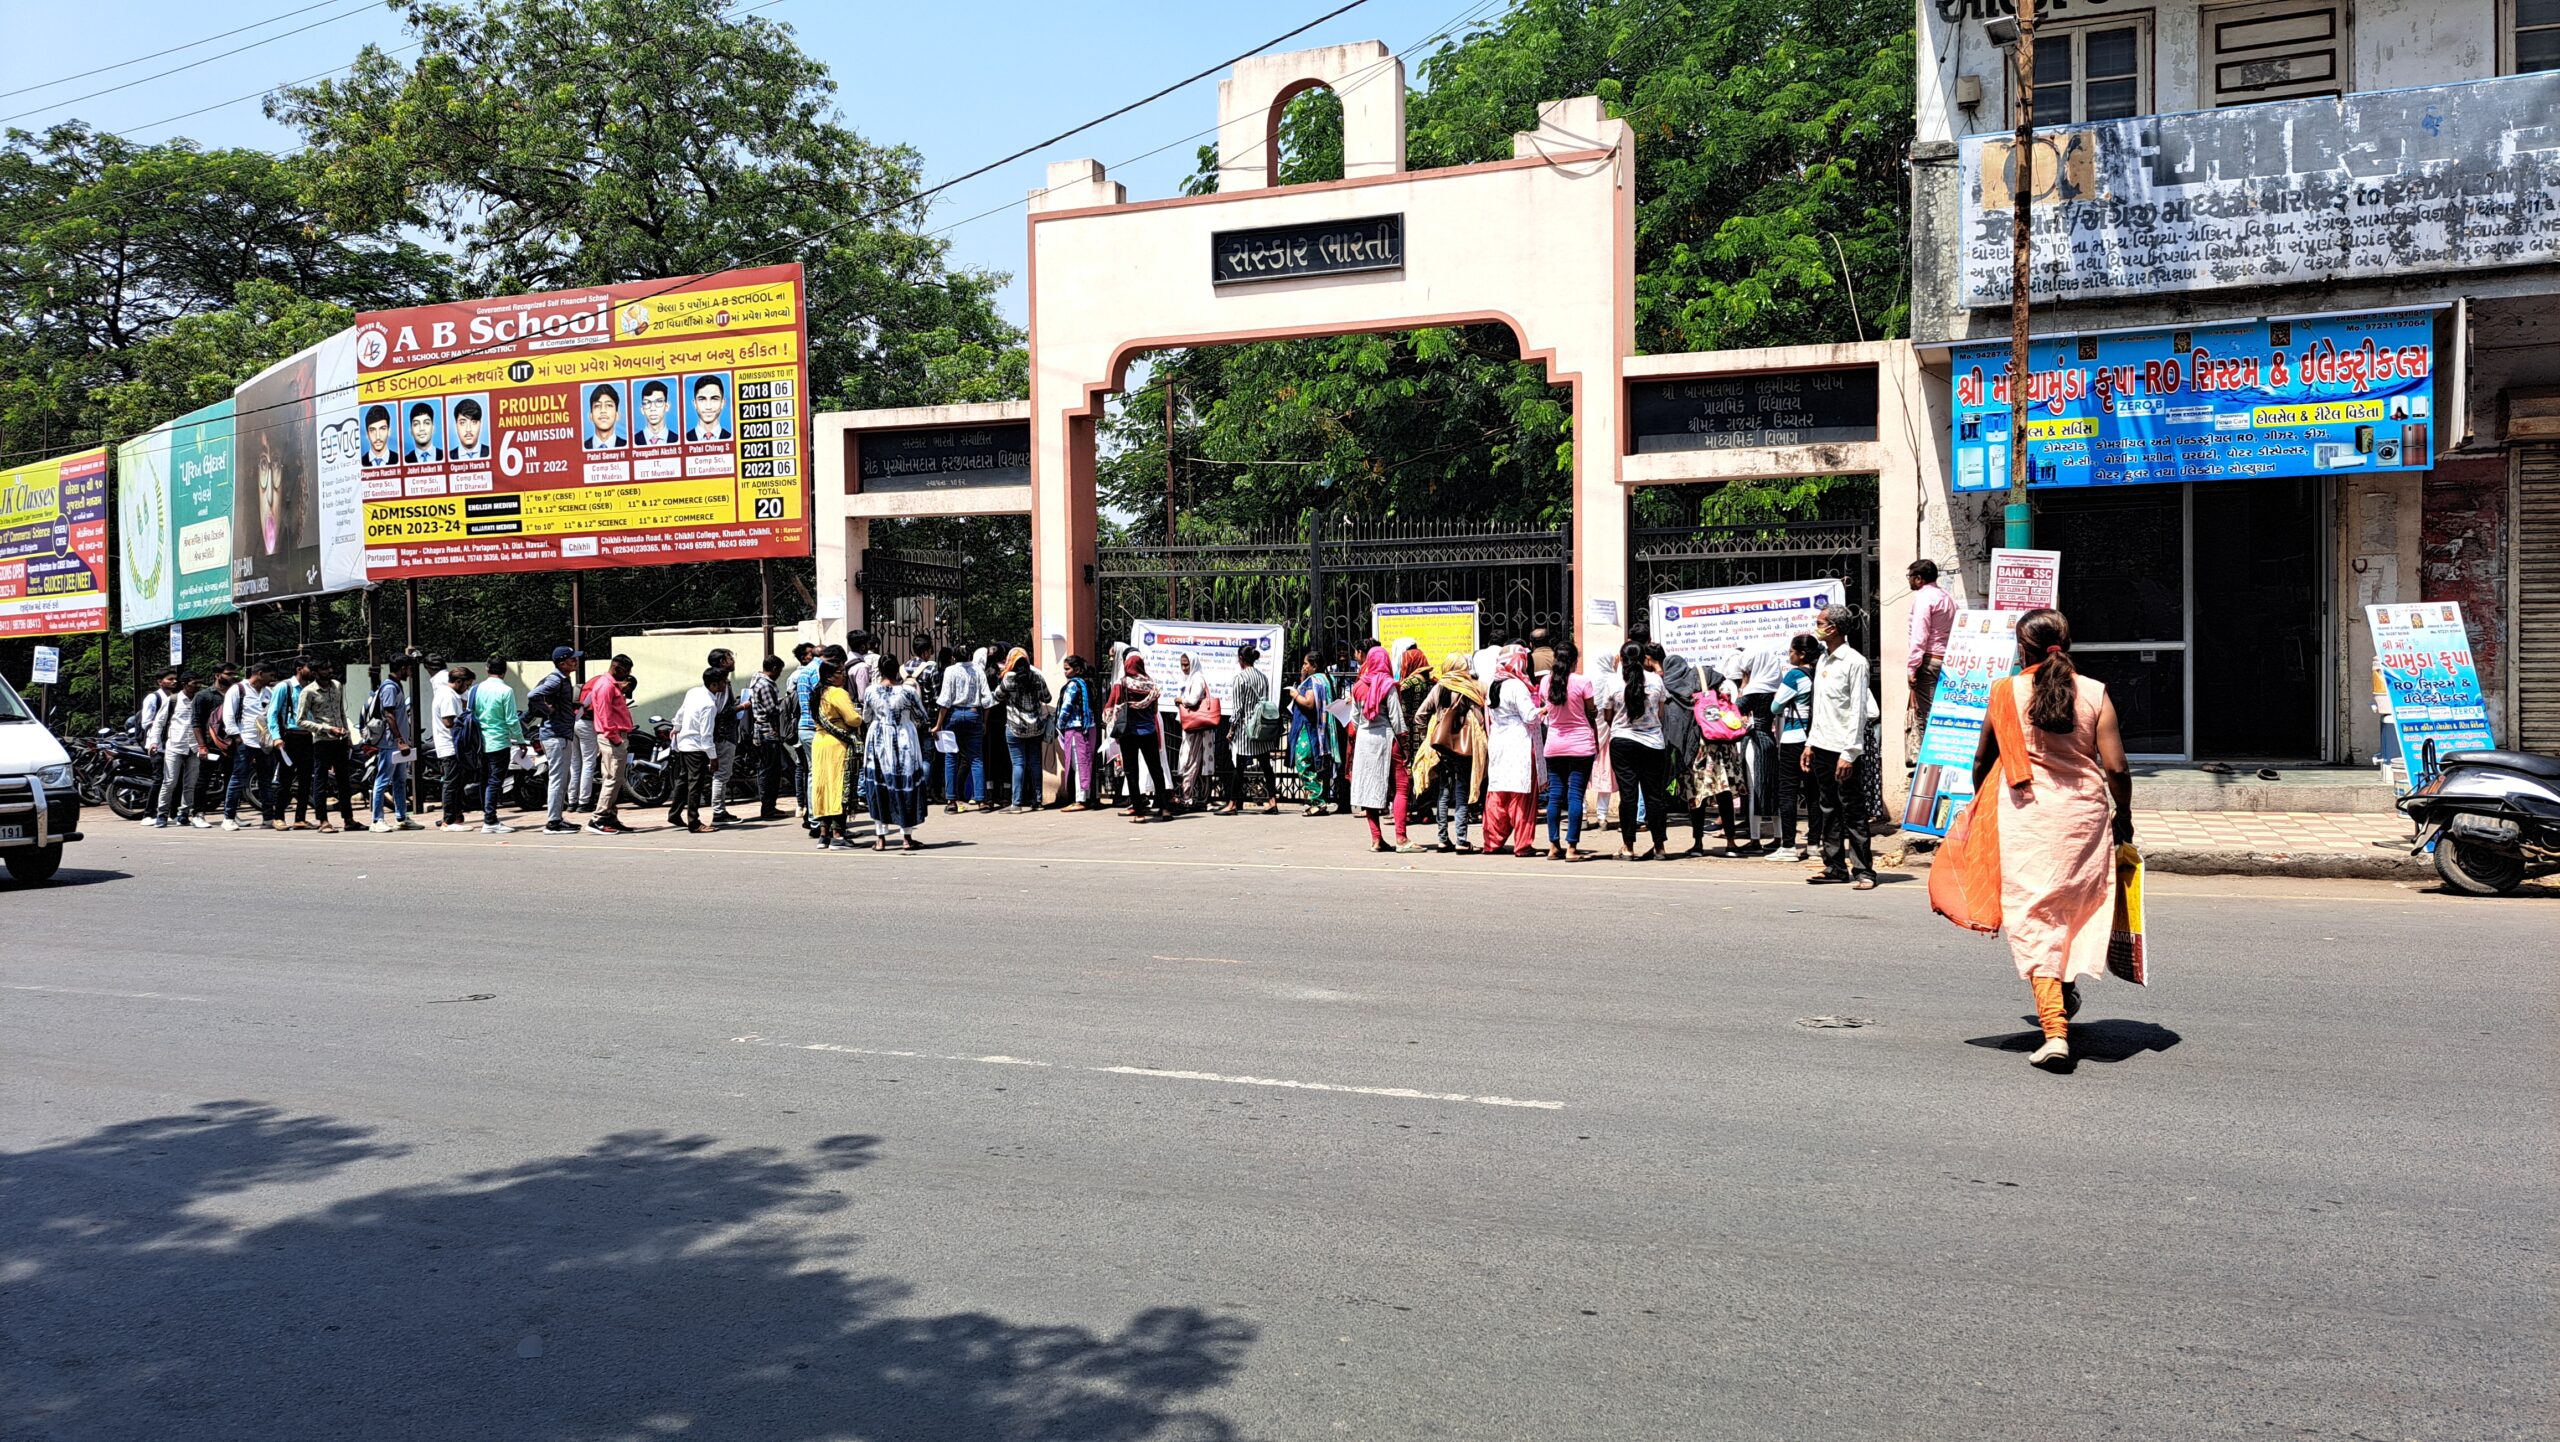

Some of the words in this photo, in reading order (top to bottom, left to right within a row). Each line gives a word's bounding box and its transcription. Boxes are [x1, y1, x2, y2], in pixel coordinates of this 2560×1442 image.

[1229, 238, 1308, 272] સંસ્કાર
[1319, 223, 1392, 264] ભારતી
[477, 304, 511, 315] Government
[513, 301, 546, 312] Recognized
[560, 296, 587, 305] Financed
[589, 294, 608, 303] School
[679, 302, 684, 310] 5
[731, 293, 773, 304] SCHOOL
[653, 322, 664, 330] 20
[717, 313, 729, 324] IIT
[743, 310, 762, 321] પ્રવેશ
[764, 306, 790, 319] મેળવ્યો
[2366, 322, 2392, 330] 97231
[2397, 320, 2425, 328] 97064
[394, 326, 420, 352] A
[432, 322, 456, 348] B
[470, 303, 609, 344] School
[412, 353, 439, 361] SCHOOL
[485, 345, 517, 354] DISTRICT
[365, 383, 373, 393] A
[378, 381, 385, 391] B
[390, 374, 446, 390] SCHOOL
[450, 373, 462, 385] ના
[467, 367, 503, 384] સથવારે
[512, 364, 530, 379] IIT
[538, 361, 550, 376] માં
[555, 363, 576, 375] પણ
[580, 357, 608, 373] પ્રવેશ
[613, 350, 666, 370] મેળવવાનું
[670, 351, 701, 365] સ્વપ્ન
[739, 342, 777, 359] હકીકત
[739, 371, 775, 381] ADMISSIONS
[777, 370, 784, 378] TO
[1661, 384, 1674, 400] શ્રી
[1811, 373, 1843, 391] પરીખ
[1957, 365, 1984, 407] શ્રી
[2095, 365, 2135, 414] કૃપા
[2144, 359, 2181, 394] RO
[2190, 346, 2259, 393] સિસ્ટમ
[2270, 351, 2290, 387] &
[741, 383, 769, 399] 2018
[775, 382, 788, 395] 06
[500, 394, 568, 414] PROUDLY
[743, 403, 769, 419] 2019
[776, 402, 788, 415] 04
[1704, 398, 1744, 416] પ્રાથમિક
[1758, 395, 1802, 412] વિદ્યાલય
[2119, 400, 2151, 412] ZERO
[499, 411, 570, 428] ANNOUNCING
[1773, 413, 1814, 428] ઉચ્ચતર
[2256, 410, 2296, 424] હોલસેલ
[2300, 411, 2308, 421] &
[2314, 406, 2341, 421] રીટેલ
[517, 427, 574, 443] ADMISSION
[743, 423, 770, 438] 2020
[776, 422, 789, 435] 02
[2048, 426, 2055, 436] &
[2061, 421, 2092, 437] સર્વિસ
[1705, 431, 1753, 449] માધ્યમિક
[1765, 429, 1798, 445] વિભાગ
[2151, 436, 2171, 446] અને
[2237, 434, 2258, 442] RO,
[500, 430, 523, 477] 6
[525, 446, 536, 458] IN
[744, 442, 770, 457] 2021
[777, 441, 789, 454] 02
[2142, 451, 2176, 462] મશીન,
[2227, 447, 2252, 458] વોટર
[525, 462, 540, 474] IIT
[544, 460, 568, 472] 2022
[744, 462, 771, 477] 2022
[777, 461, 790, 474] 06
[864, 457, 878, 474] શેઠ
[2096, 468, 2120, 479] વોટર
[2154, 467, 2175, 477] તથા
[2229, 462, 2275, 475] સોલ્યુશન
[751, 479, 797, 488] ADMISSIONS
[758, 487, 780, 496] TOTAL
[0, 487, 15, 515] JK
[17, 484, 55, 511] Classes
[617, 488, 641, 497] (GSEB)
[663, 496, 703, 506] COMMERCE
[705, 494, 729, 504] (GSEB)
[371, 504, 456, 521] ADMISSIONS
[468, 503, 492, 512] ENGLISH
[493, 501, 518, 509] MEDIUM
[589, 503, 612, 511] (GSEB)
[758, 499, 781, 517] 20
[674, 514, 714, 522] COMMERCE
[368, 523, 402, 536] OPEN
[407, 520, 461, 534] 2023-24
[496, 523, 517, 531] MEDIUM
[601, 535, 644, 544] Chikhli-Vansda
[646, 533, 662, 542] Road,
[675, 532, 695, 540] Chikhli
[722, 529, 747, 538] Khundh,
[368, 553, 395, 562] Partapore
[1999, 568, 2025, 577] BANK
[2033, 569, 2051, 578] SSC
[1690, 605, 1730, 616] નવસારી
[1767, 599, 1801, 609] પોલીસ
[1164, 636, 1194, 645] નવસારી
[1986, 657, 2009, 678] કૃપા
[2385, 646, 2432, 675] ચામુંડા
[2440, 651, 2469, 674] કૃપા
[1960, 679, 1987, 690] સિસ્ટમ
[2394, 682, 2413, 690] RO
[2419, 678, 2455, 689] સિસ્ટમ
[2461, 679, 2470, 687] &
